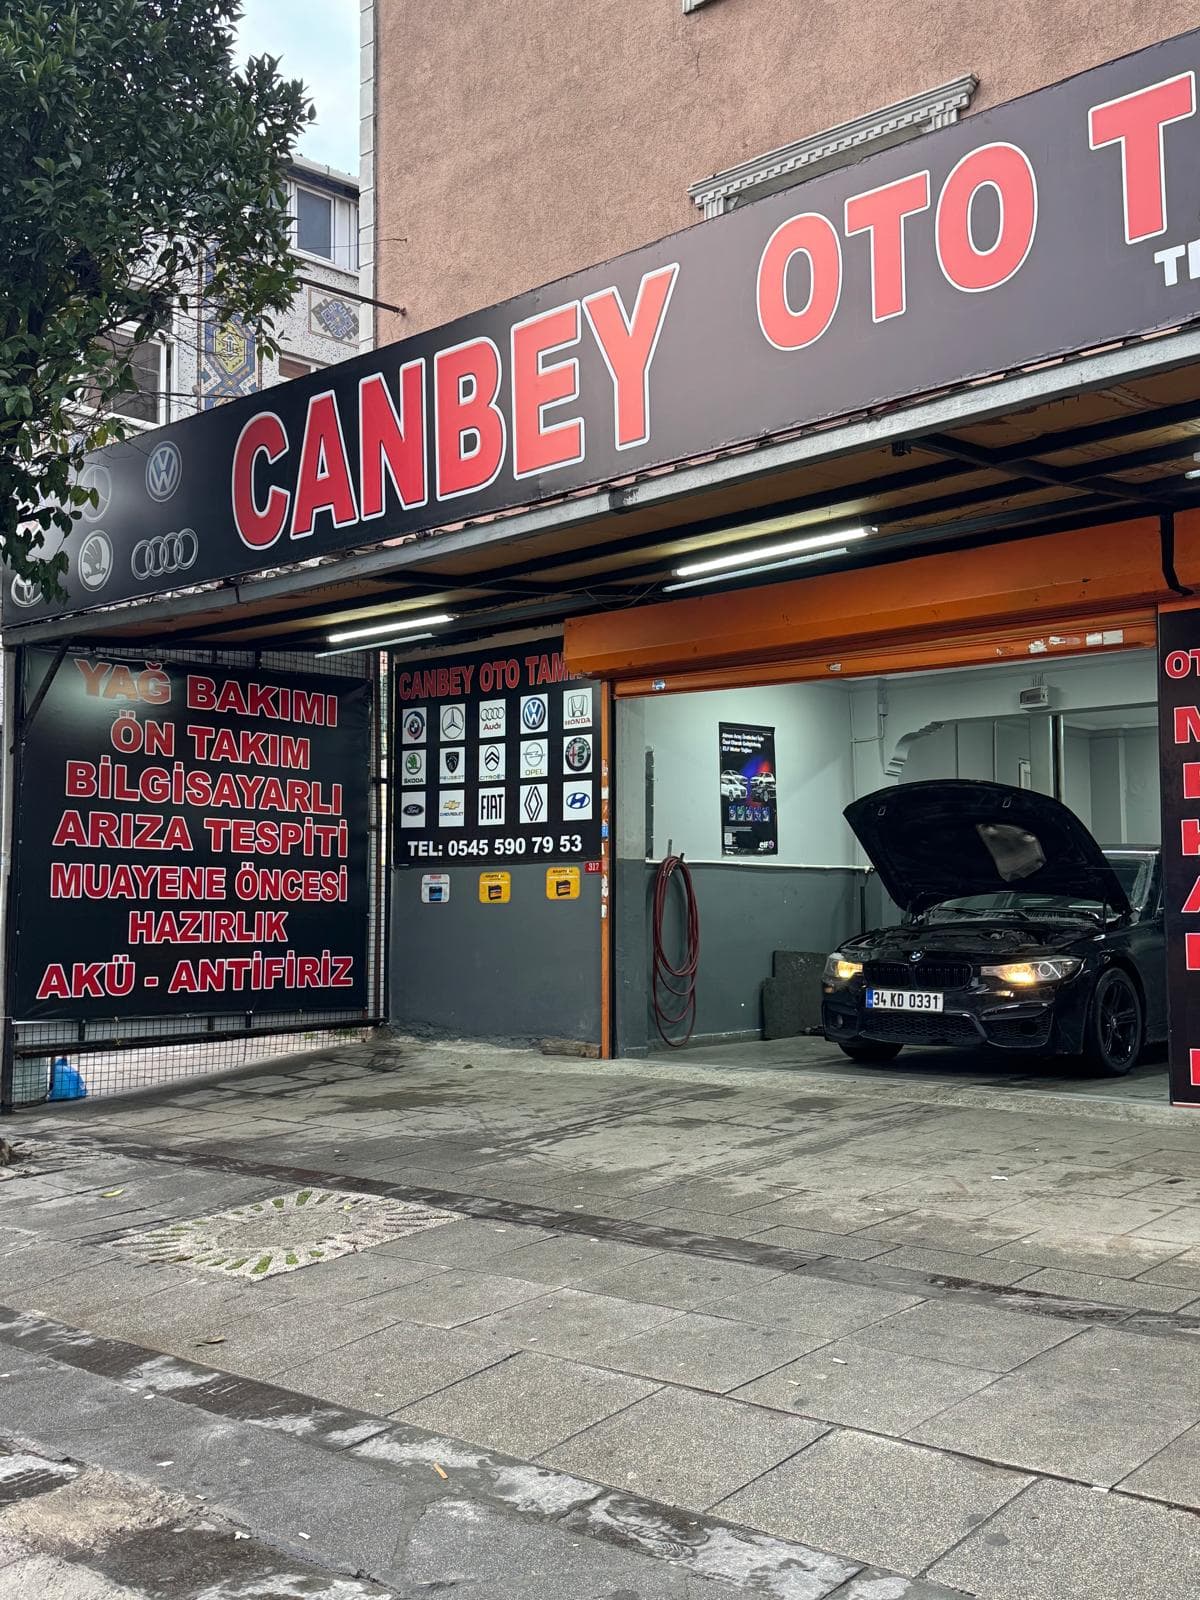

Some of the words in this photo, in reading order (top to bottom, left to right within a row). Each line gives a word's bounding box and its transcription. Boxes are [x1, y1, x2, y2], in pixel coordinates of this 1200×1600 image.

[232, 262, 680, 551] CANBEY
[756, 141, 1038, 351] OTO
[1088, 70, 1200, 245] T
[75, 658, 172, 705] YAĞ
[187, 675, 338, 727] BAKIMI
[399, 665, 475, 700] CANBEY
[479, 658, 520, 692] OTO
[525, 652, 582, 686] TAM
[111, 710, 174, 757] ÖN
[187, 725, 310, 770] TAKIM
[483, 722, 501, 730] Audi
[565, 717, 591, 726] HONDA
[65, 755, 343, 815] BİLGİSAYARLI
[525, 768, 544, 776] OPEL
[481, 794, 504, 820] FIAT
[52, 810, 193, 850] ARIZA
[203, 817, 348, 858] TESPİTİ
[407, 841, 443, 857] TEL:
[448, 839, 489, 856] 0545
[494, 837, 526, 855] 590
[531, 836, 554, 854] 79
[559, 834, 582, 852] 53
[50, 862, 226, 900] MUAYENE
[235, 862, 348, 902] ÖNCESİ
[128, 911, 289, 944] HAZIRLIK
[36, 955, 136, 1000] AKÜ
[168, 950, 354, 993] ANTİFİRİZ
[873, 992, 886, 1006] 34
[890, 993, 904, 1007] KD
[909, 994, 938, 1009] 0331
